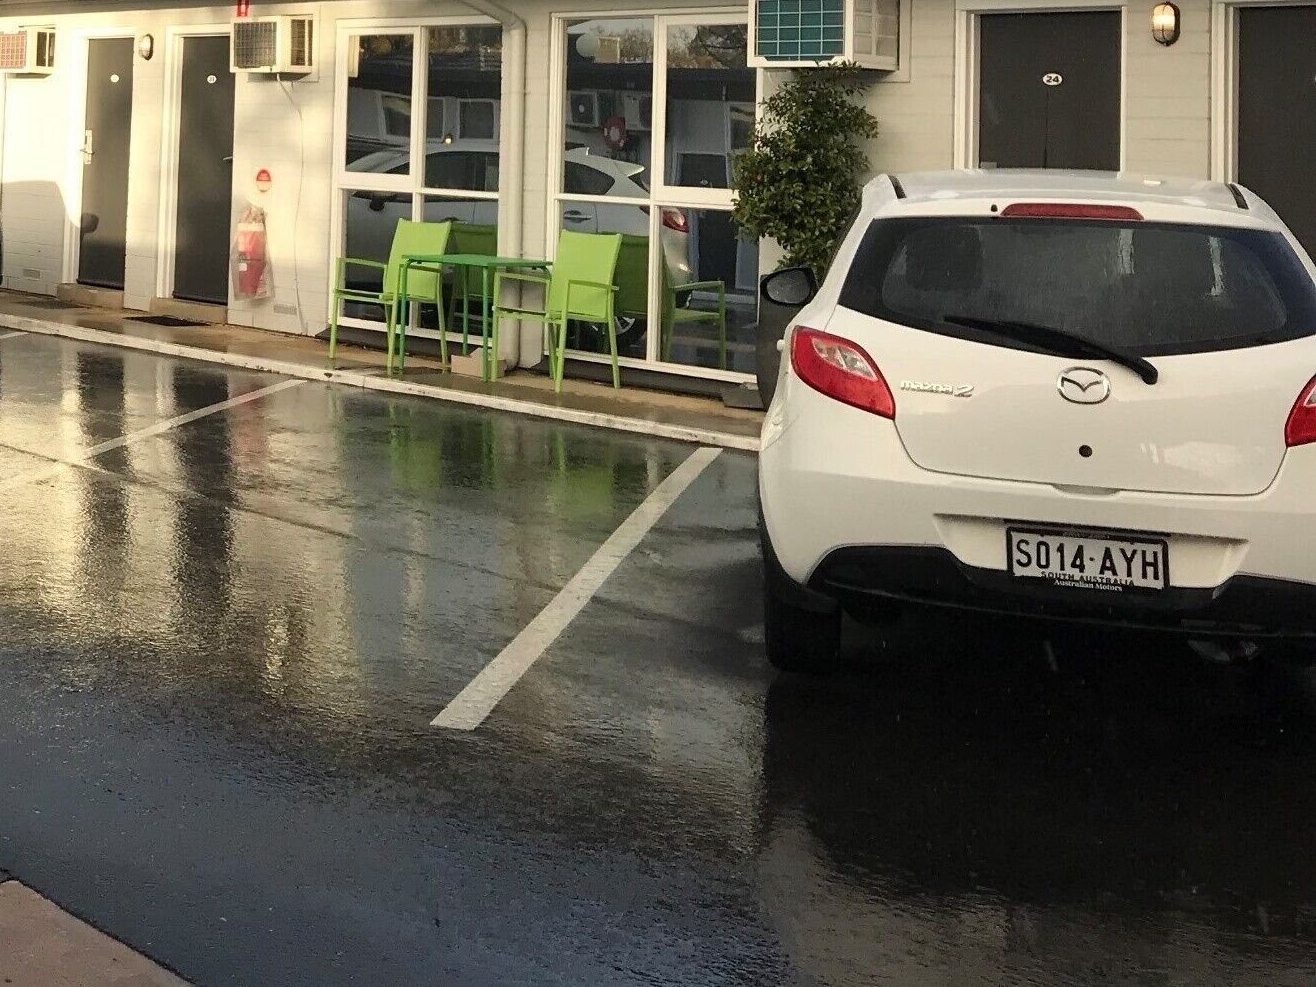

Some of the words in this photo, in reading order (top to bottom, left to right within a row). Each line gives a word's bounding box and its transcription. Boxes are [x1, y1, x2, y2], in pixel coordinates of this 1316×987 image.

[1046, 75, 1059, 83] 24
[1040, 570, 1075, 581] SOUTH
[1079, 574, 1135, 588] AUSTRALIA
[1053, 579, 1094, 590] Australian
[1095, 582, 1123, 592] Motors
